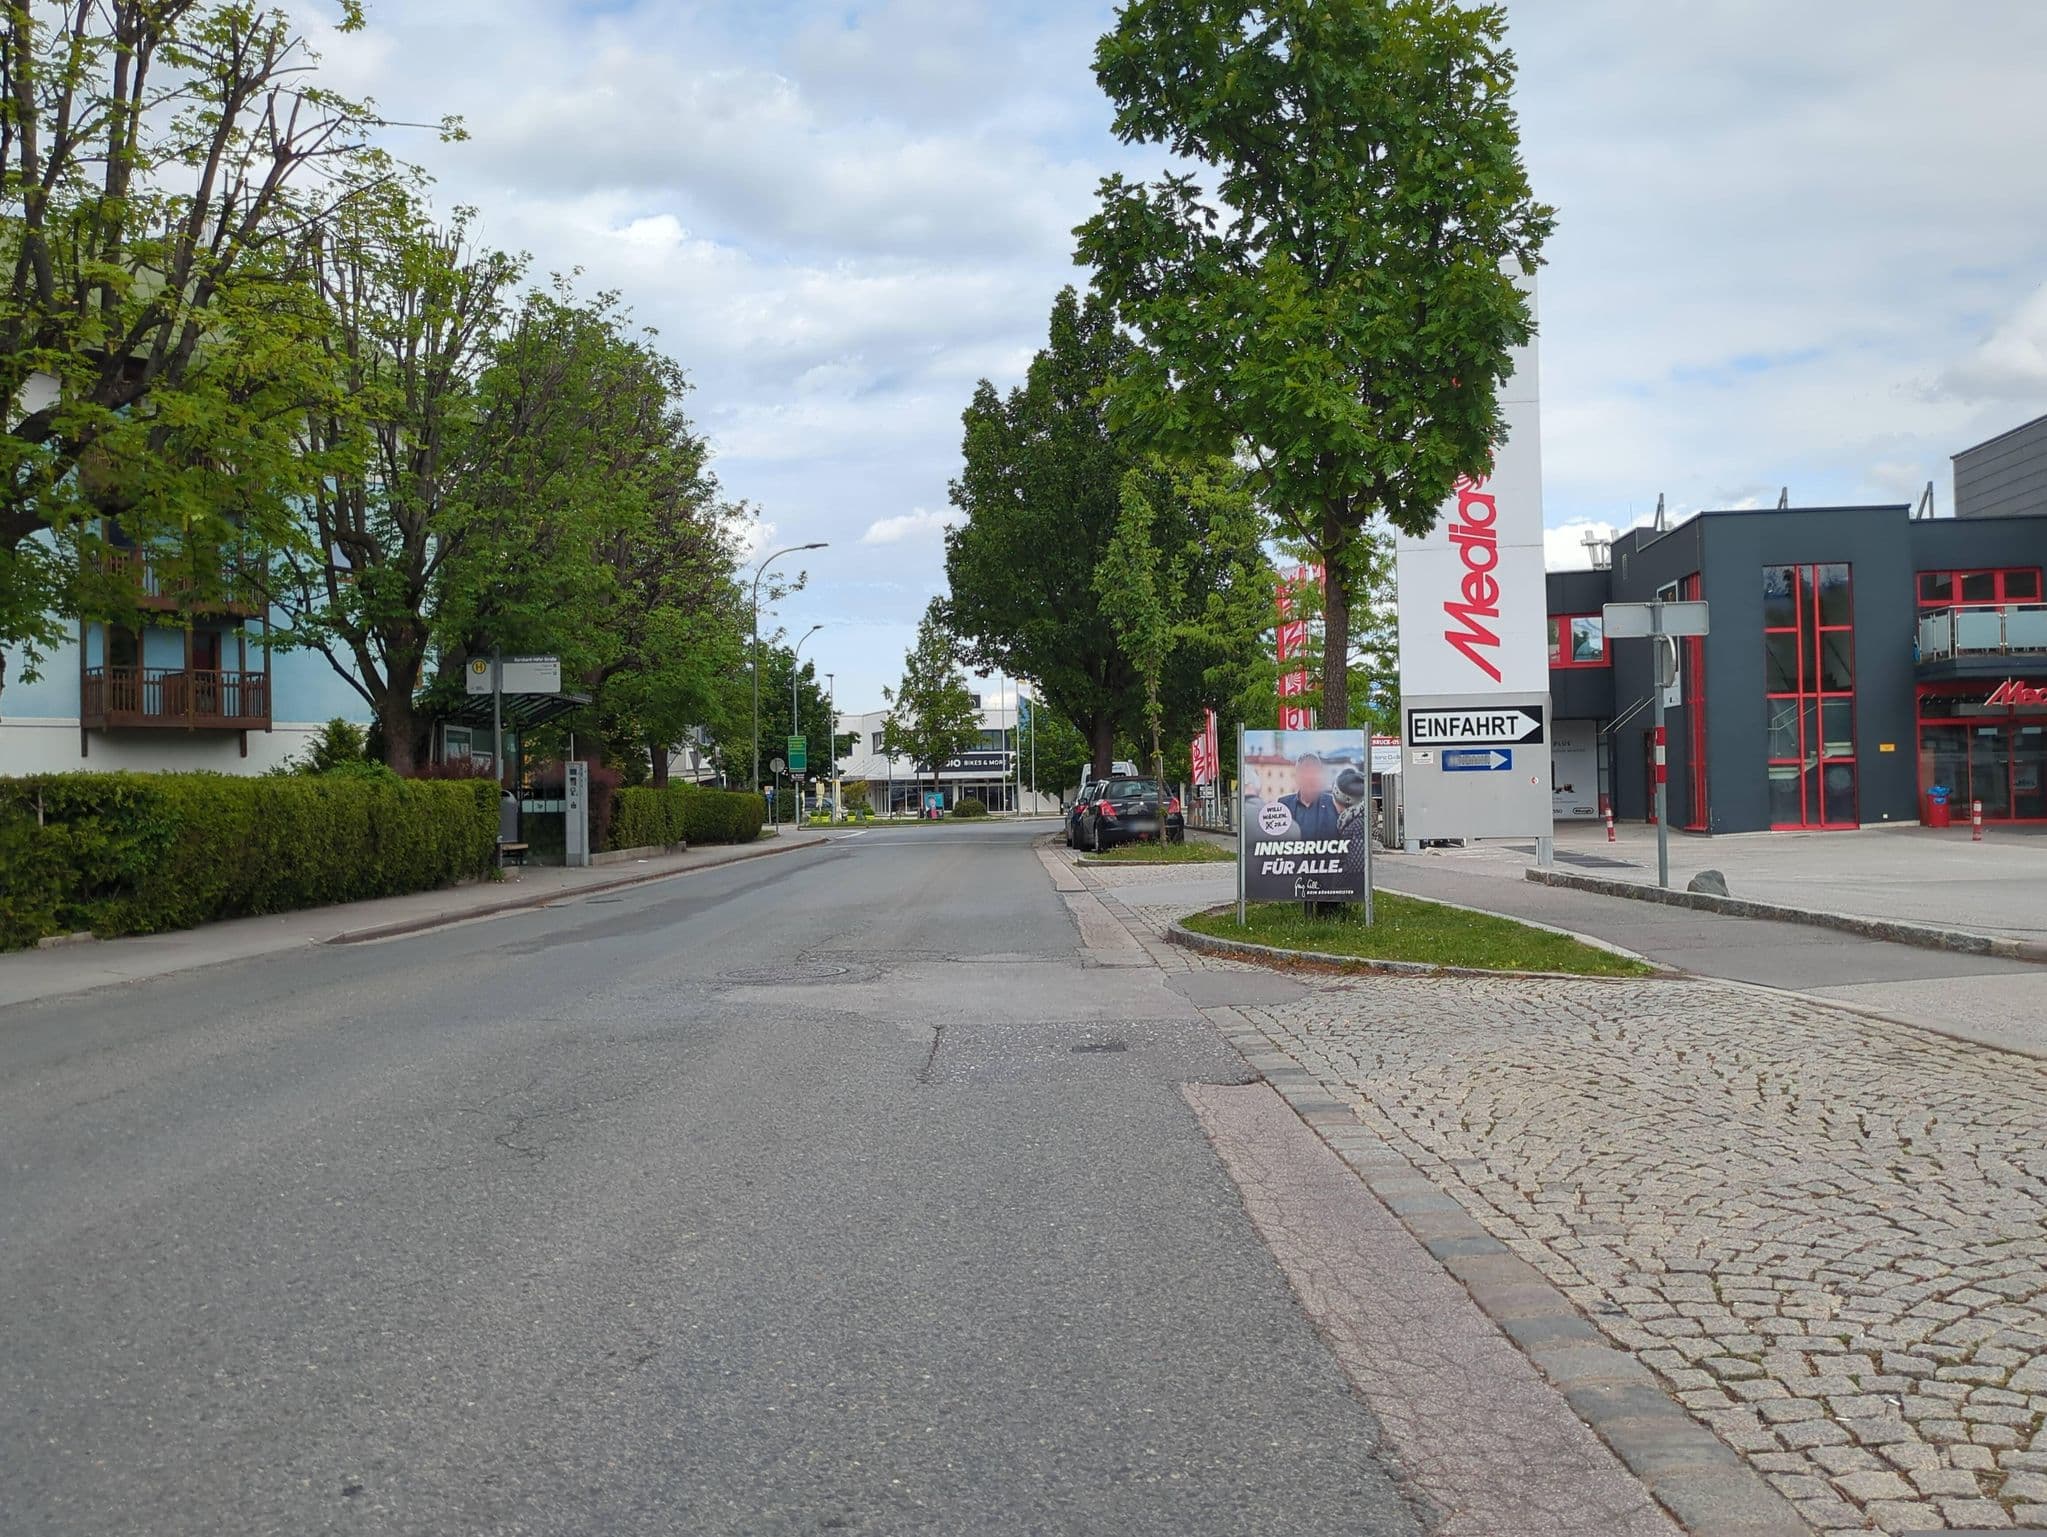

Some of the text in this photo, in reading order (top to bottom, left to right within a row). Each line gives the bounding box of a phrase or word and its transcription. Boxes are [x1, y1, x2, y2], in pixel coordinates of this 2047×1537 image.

[1414, 716, 1519, 737] EINFAHRT
[1254, 839, 1351, 856] INNSBRUCK
[1261, 858, 1343, 875] FÜR ALLE.
